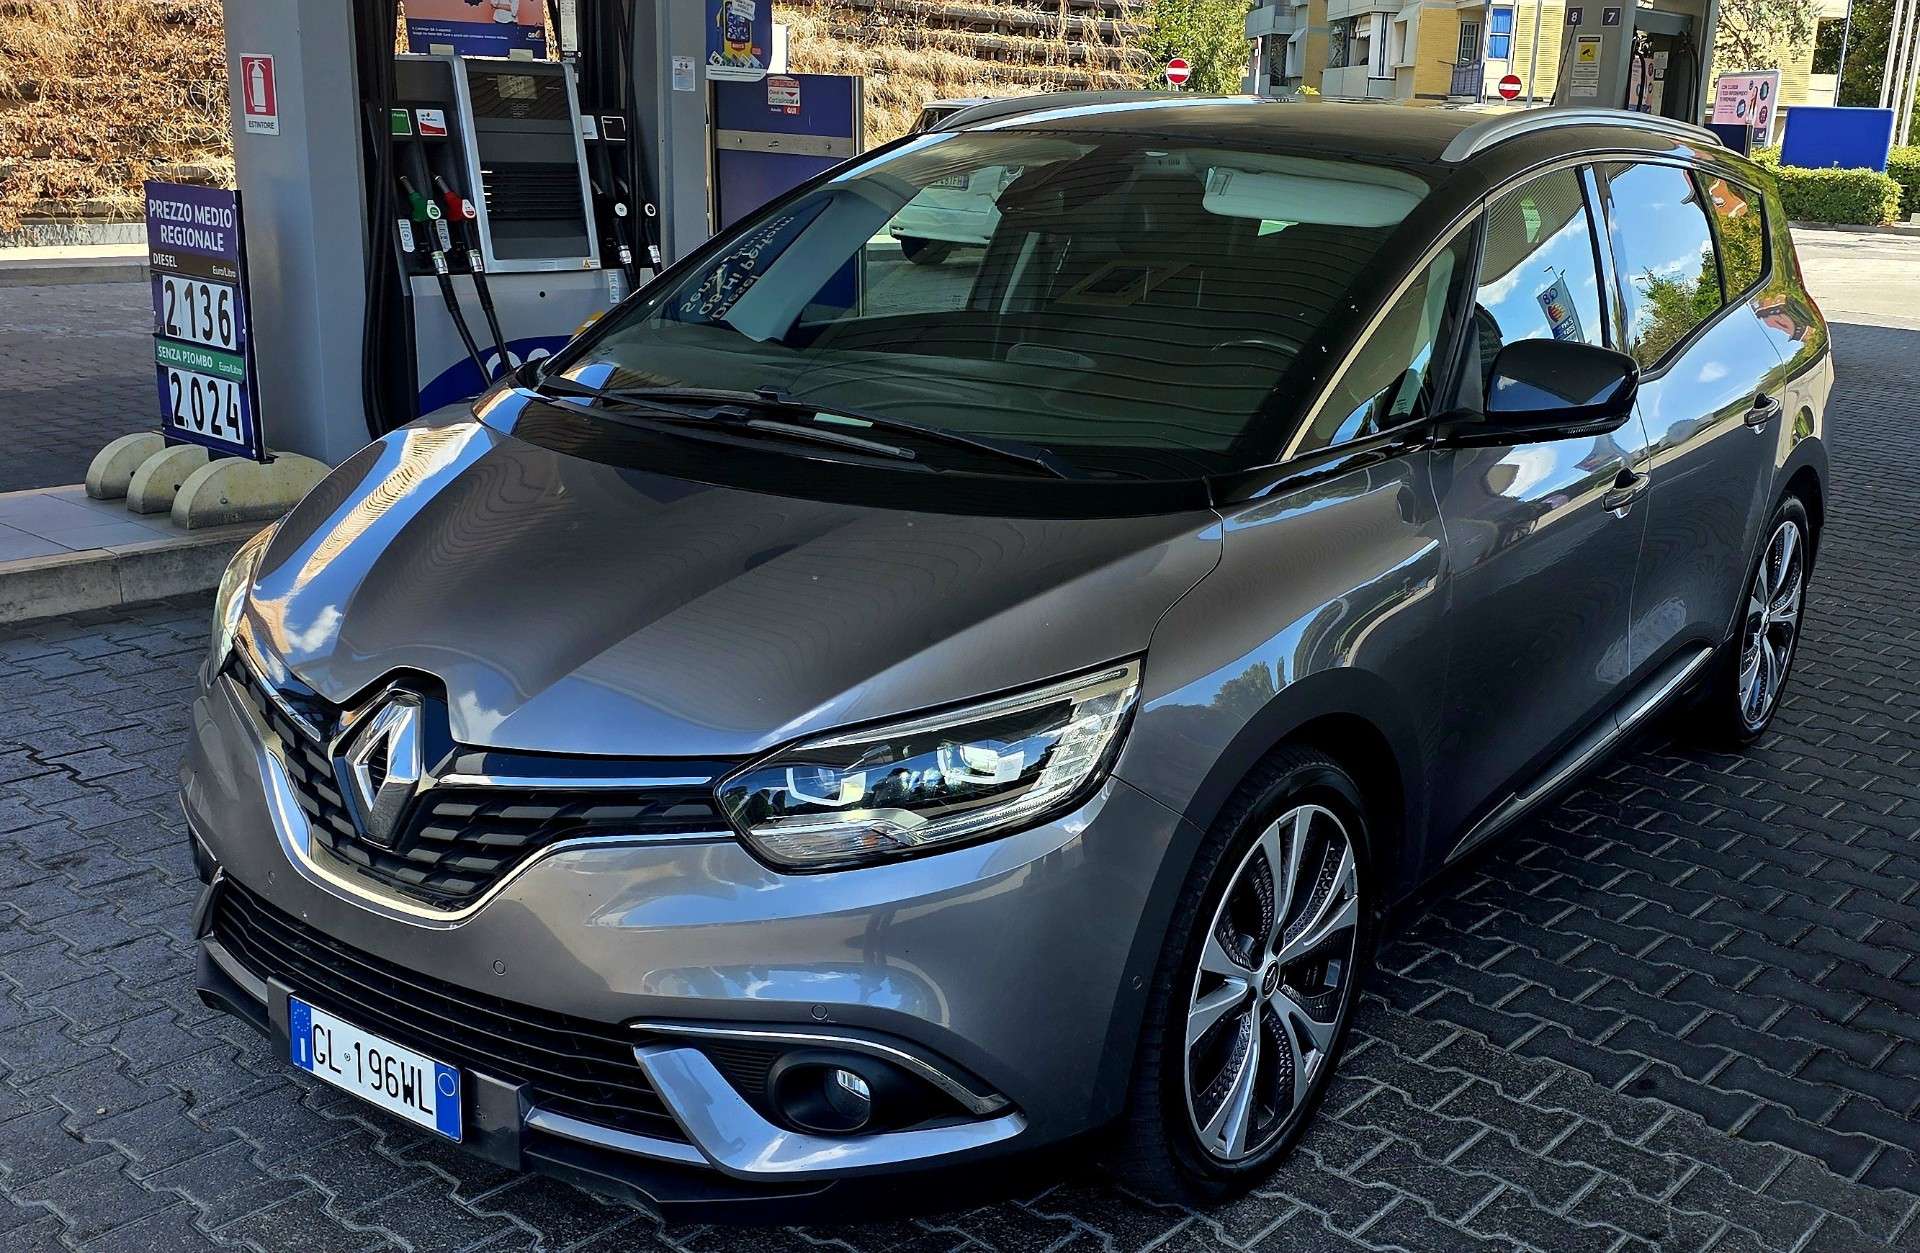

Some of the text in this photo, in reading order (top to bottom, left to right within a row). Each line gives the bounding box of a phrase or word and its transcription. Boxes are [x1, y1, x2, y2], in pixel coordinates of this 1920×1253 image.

[1571, 12, 1578, 22] 8
[1607, 12, 1616, 23] 7
[248, 121, 275, 129] ESTINTORE
[149, 199, 232, 228] PREZZO MEDIO
[160, 224, 224, 252] REGIONALE
[153, 253, 178, 268] DIESEL
[158, 346, 182, 361] SENZA
[182, 351, 213, 368] PIOMBO
[313, 1023, 433, 1115] GL 196WL
